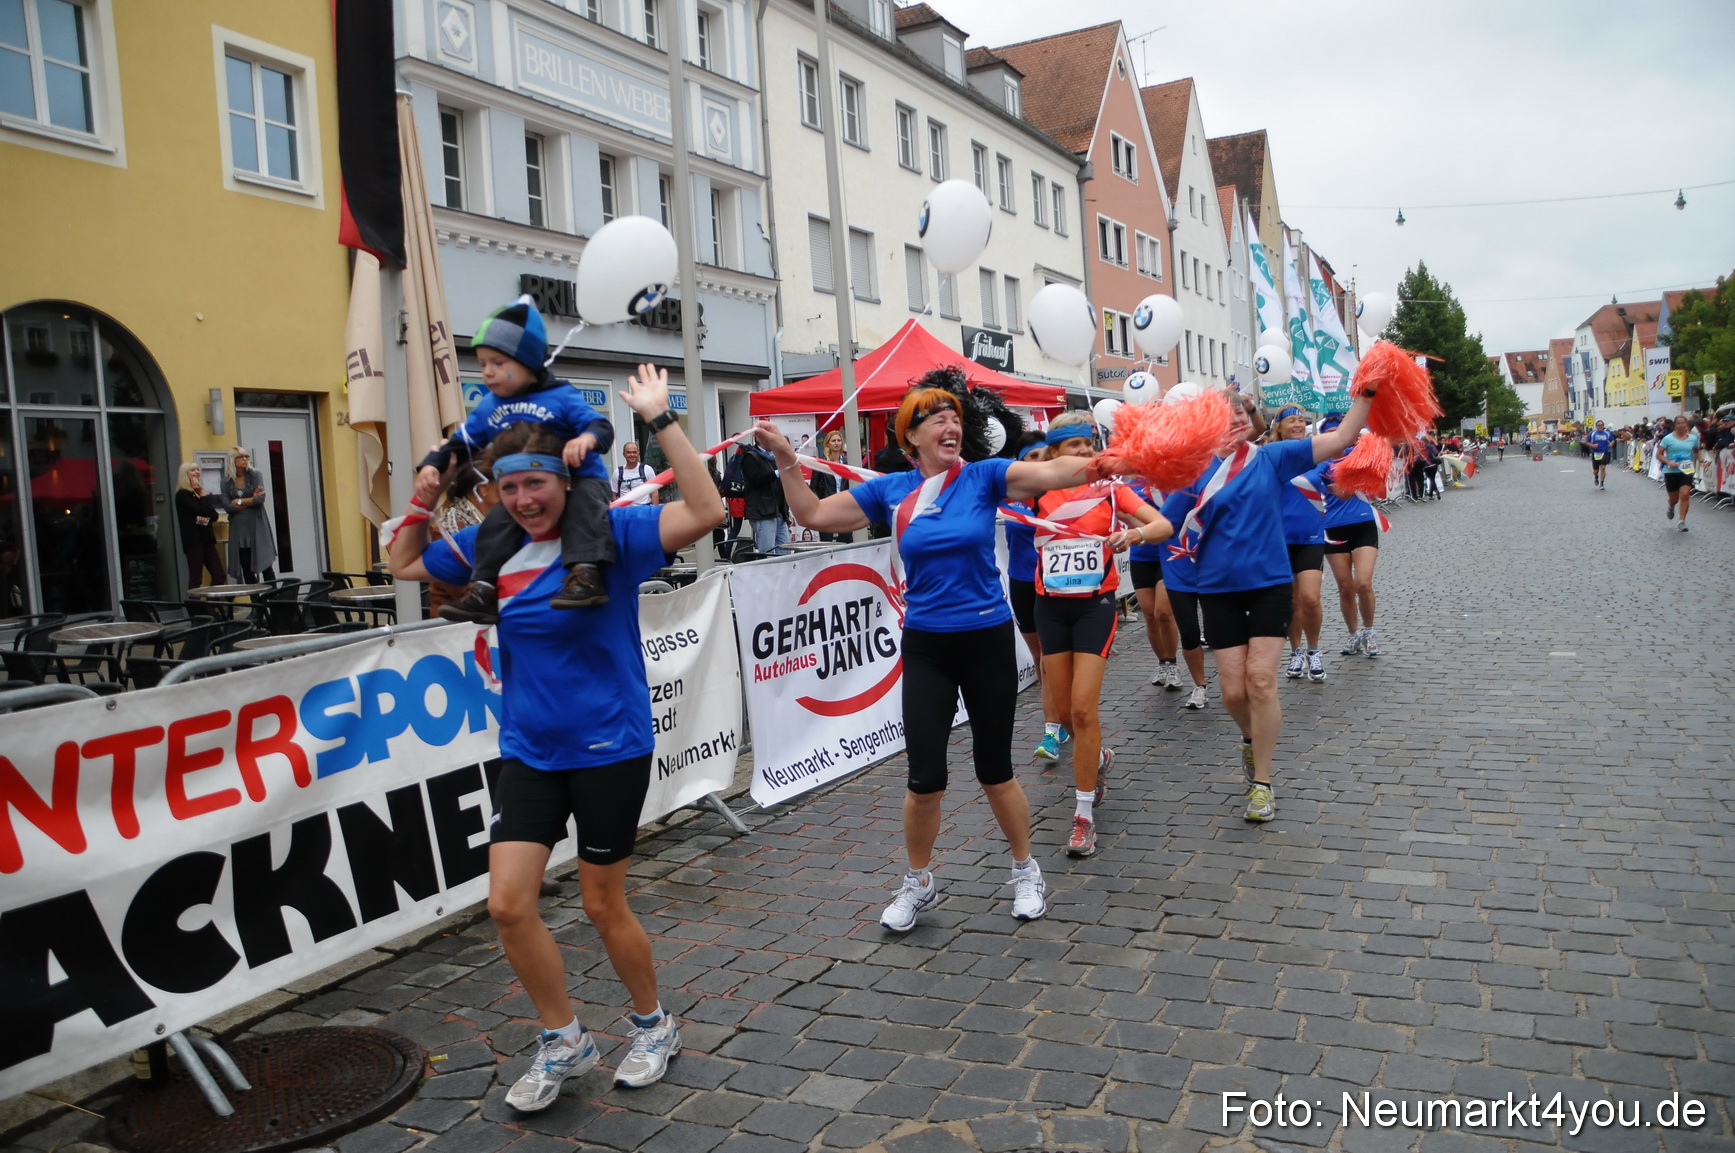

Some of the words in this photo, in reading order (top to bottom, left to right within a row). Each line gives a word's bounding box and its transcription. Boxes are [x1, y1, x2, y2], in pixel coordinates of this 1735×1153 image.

[524, 43, 606, 102] BRILLEN
[1648, 357, 1669, 366] swn
[1670, 378, 1680, 391] B
[1049, 550, 1098, 574] 2756
[1065, 577, 1082, 586] Jina
[752, 595, 874, 660] GERHART
[875, 601, 883, 618] &
[754, 652, 818, 683] Autohaus
[816, 626, 897, 680] JÄNIG
[657, 728, 737, 781] Neumarkt
[762, 746, 835, 790] Neumarkt
